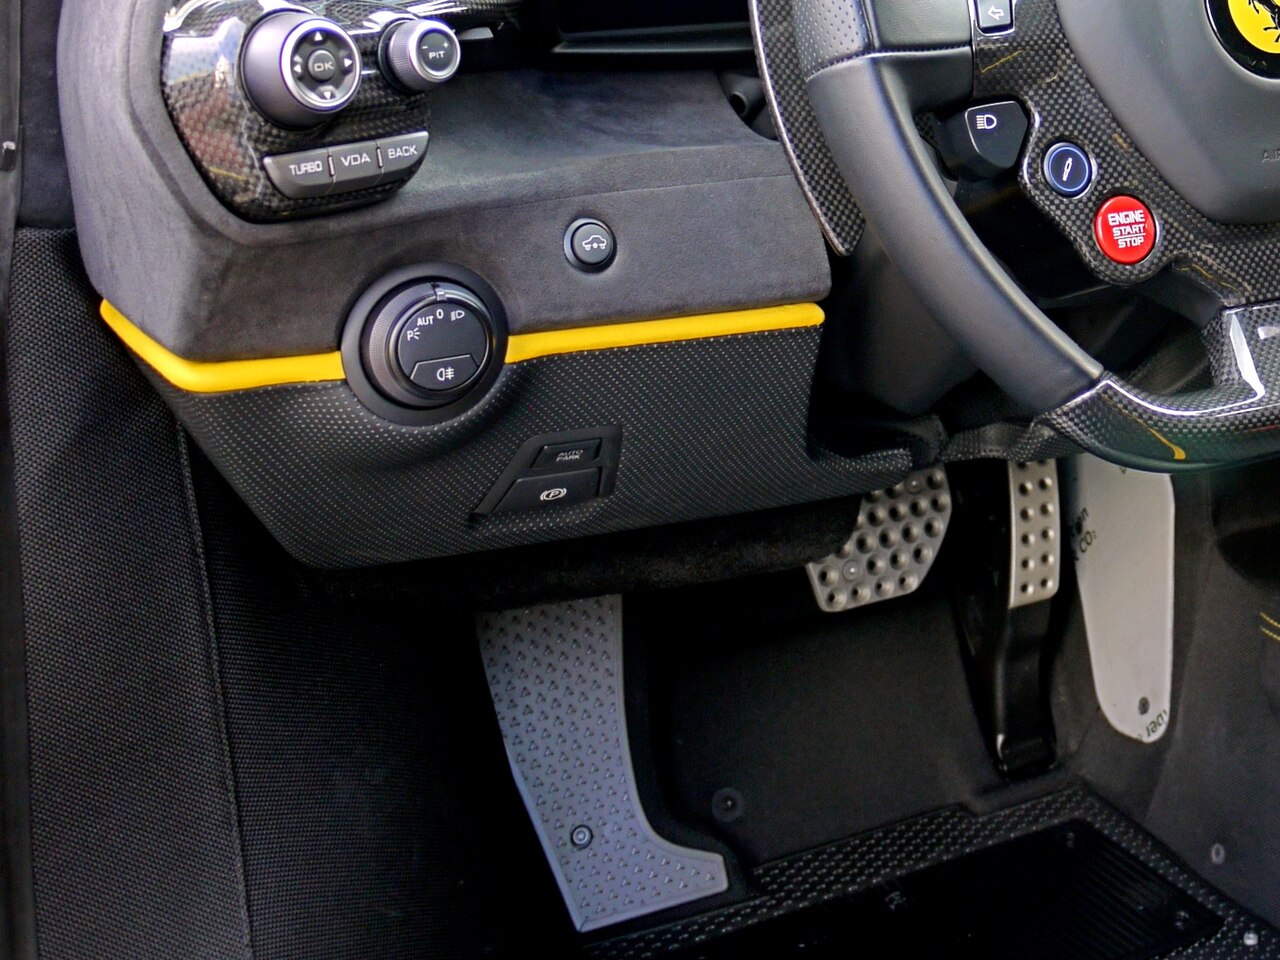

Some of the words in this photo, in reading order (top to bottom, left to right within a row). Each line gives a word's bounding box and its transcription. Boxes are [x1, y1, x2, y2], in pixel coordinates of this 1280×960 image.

[428, 50, 445, 60] PIT
[313, 60, 335, 72] OK
[387, 145, 418, 159] BACK
[340, 152, 371, 167] VDA
[288, 161, 323, 176] TURBO
[1107, 209, 1146, 227] ENGINE
[1112, 223, 1145, 236] START
[1117, 236, 1145, 249] STOP
[417, 315, 434, 326] AUT
